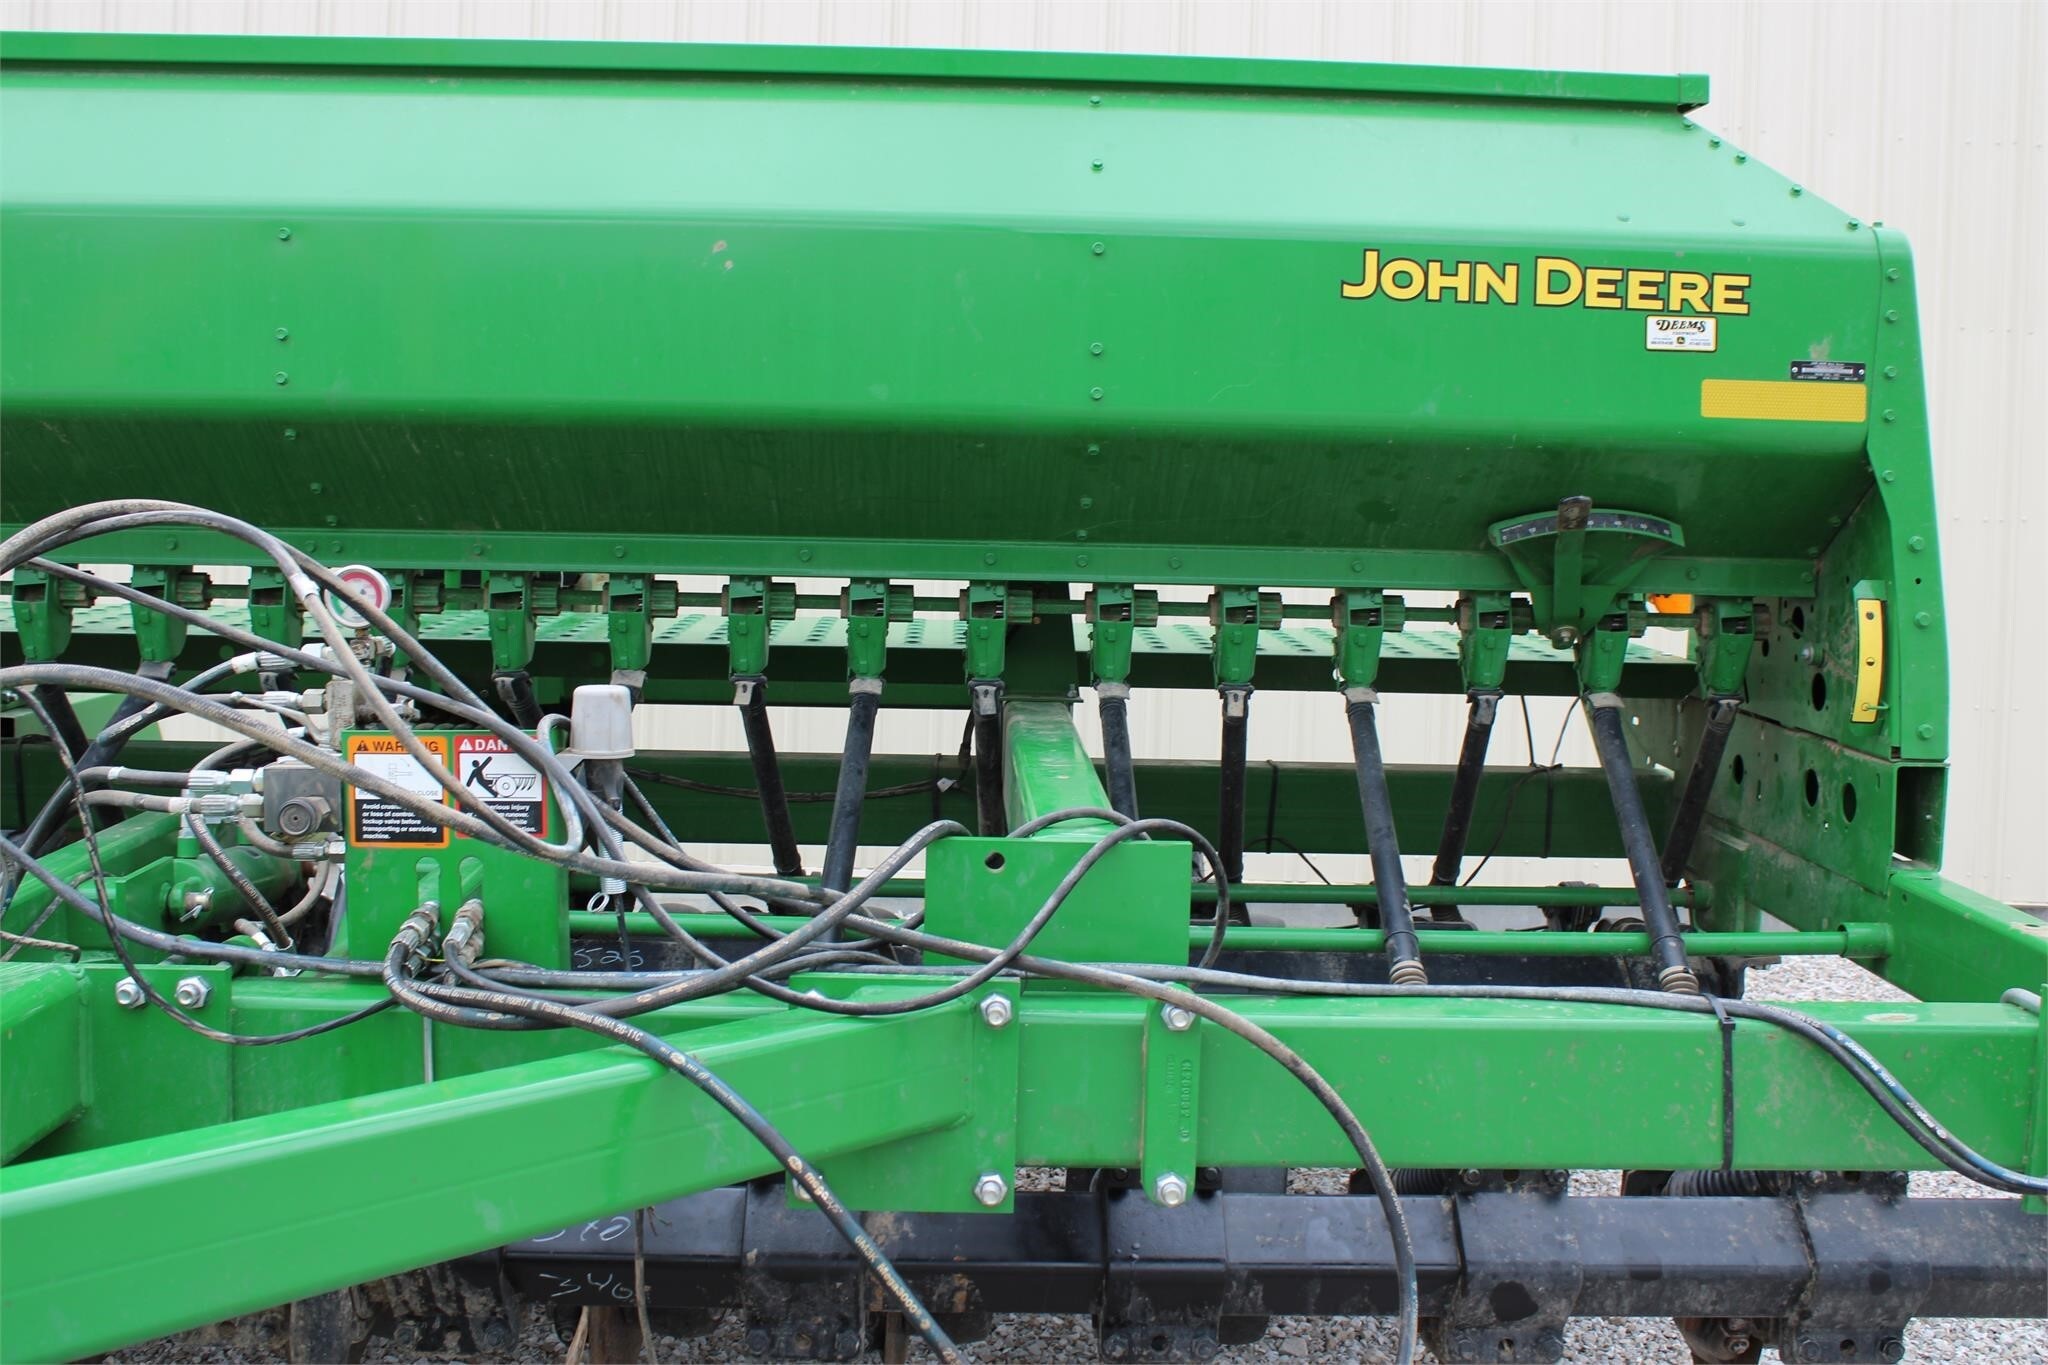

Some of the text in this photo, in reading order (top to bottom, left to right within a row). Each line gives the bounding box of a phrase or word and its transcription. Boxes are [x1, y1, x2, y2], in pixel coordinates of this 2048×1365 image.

[1341, 248, 1751, 316] JOHN DEERE
[1656, 319, 1706, 332] DEEMS
[475, 740, 509, 750] DAN
